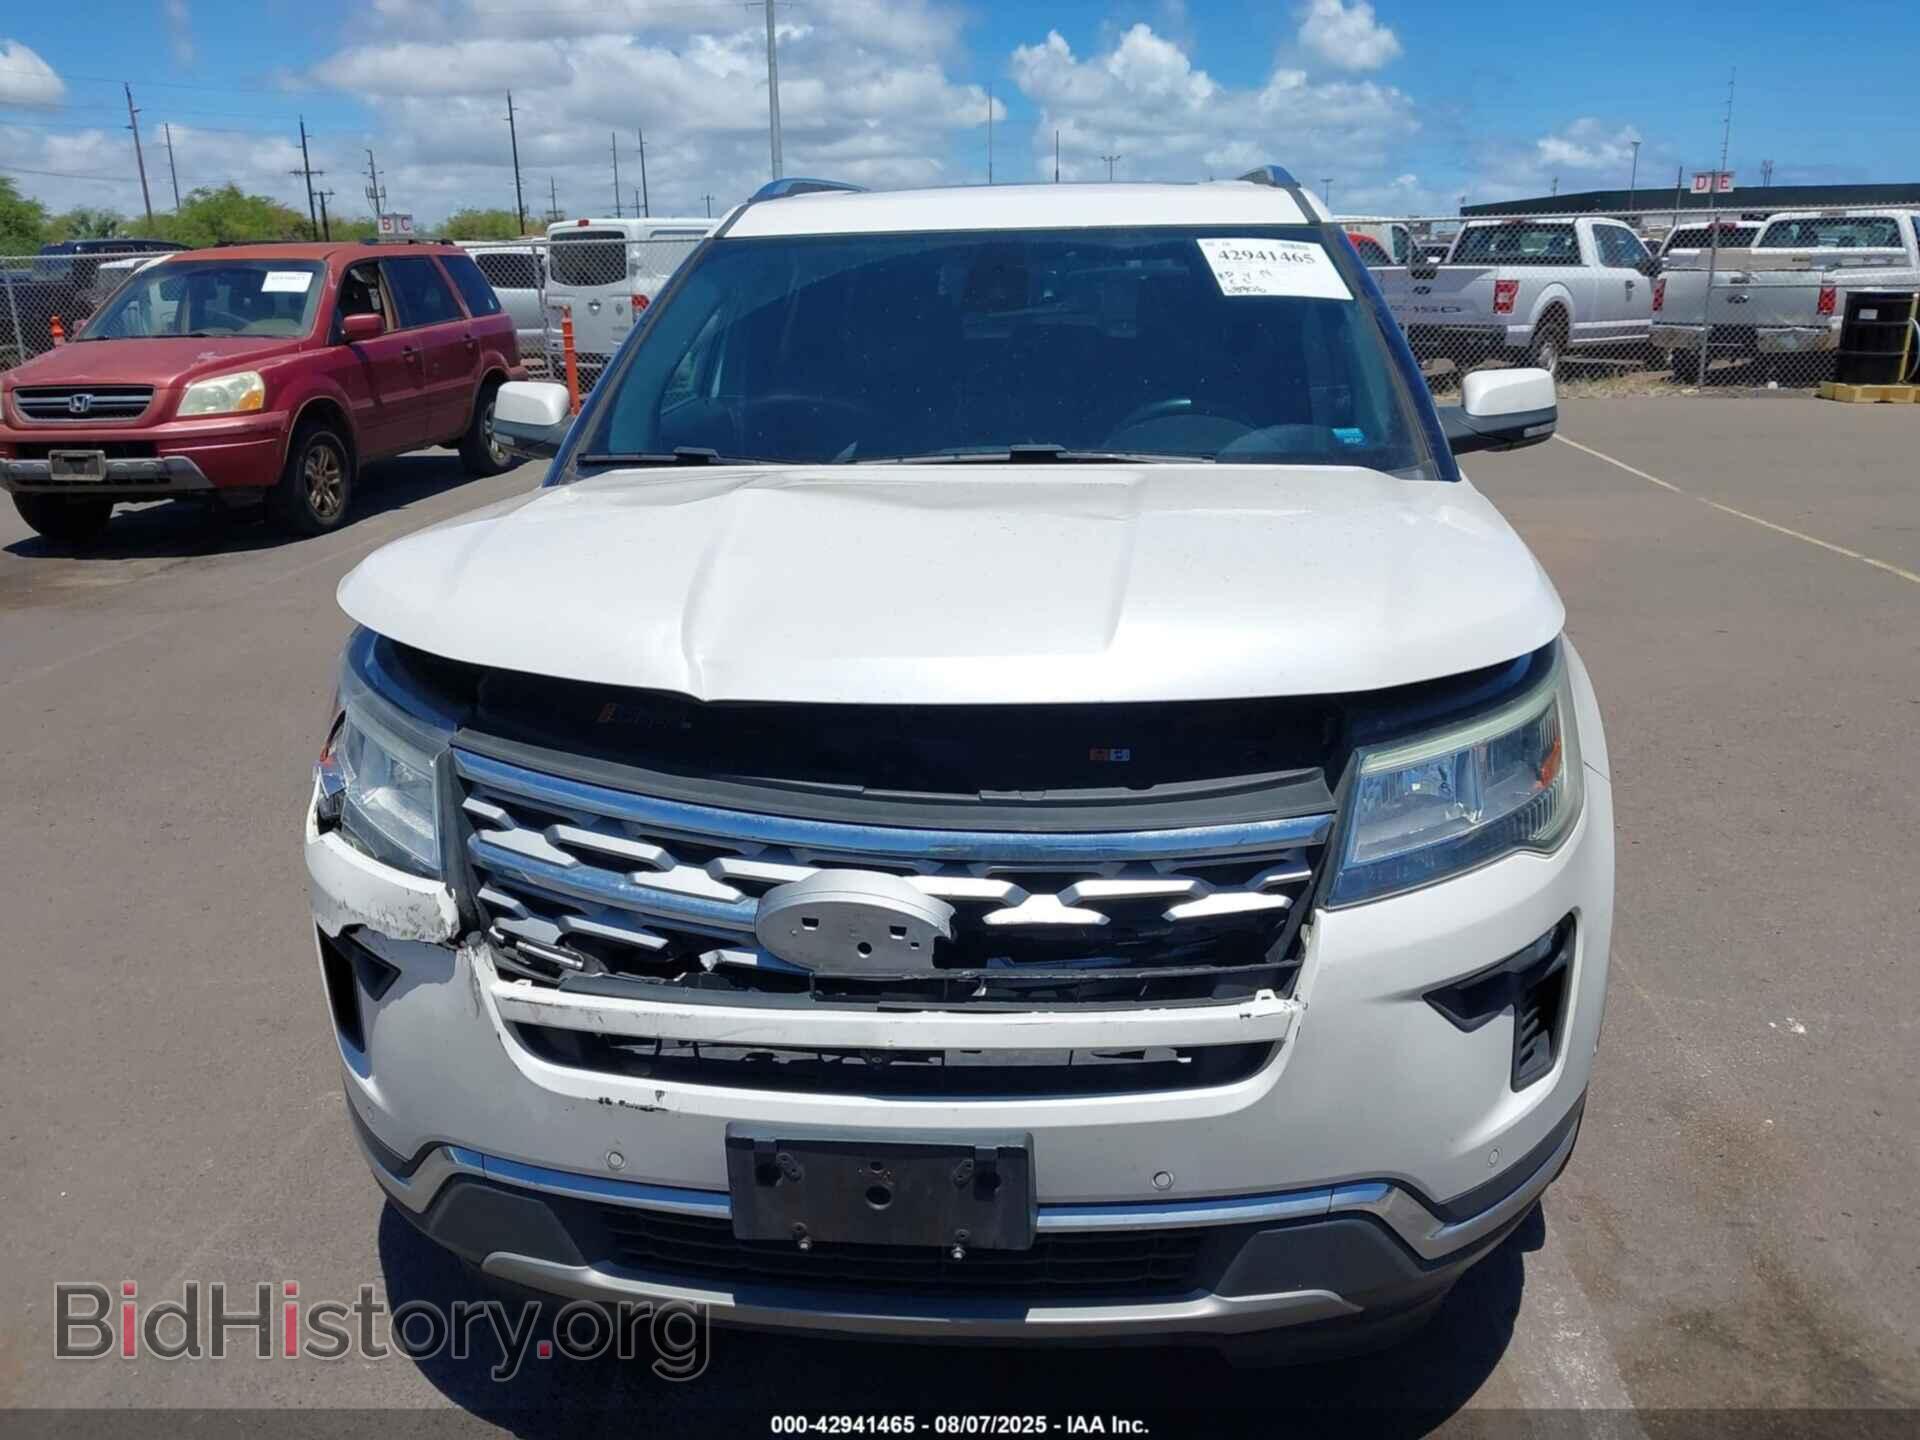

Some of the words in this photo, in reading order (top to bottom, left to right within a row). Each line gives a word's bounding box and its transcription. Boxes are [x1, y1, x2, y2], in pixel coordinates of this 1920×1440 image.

[1695, 175, 1706, 190] D
[1719, 174, 1729, 189] E
[383, 217, 392, 231] B
[400, 217, 410, 231] C
[1218, 250, 1316, 265] 42941465
